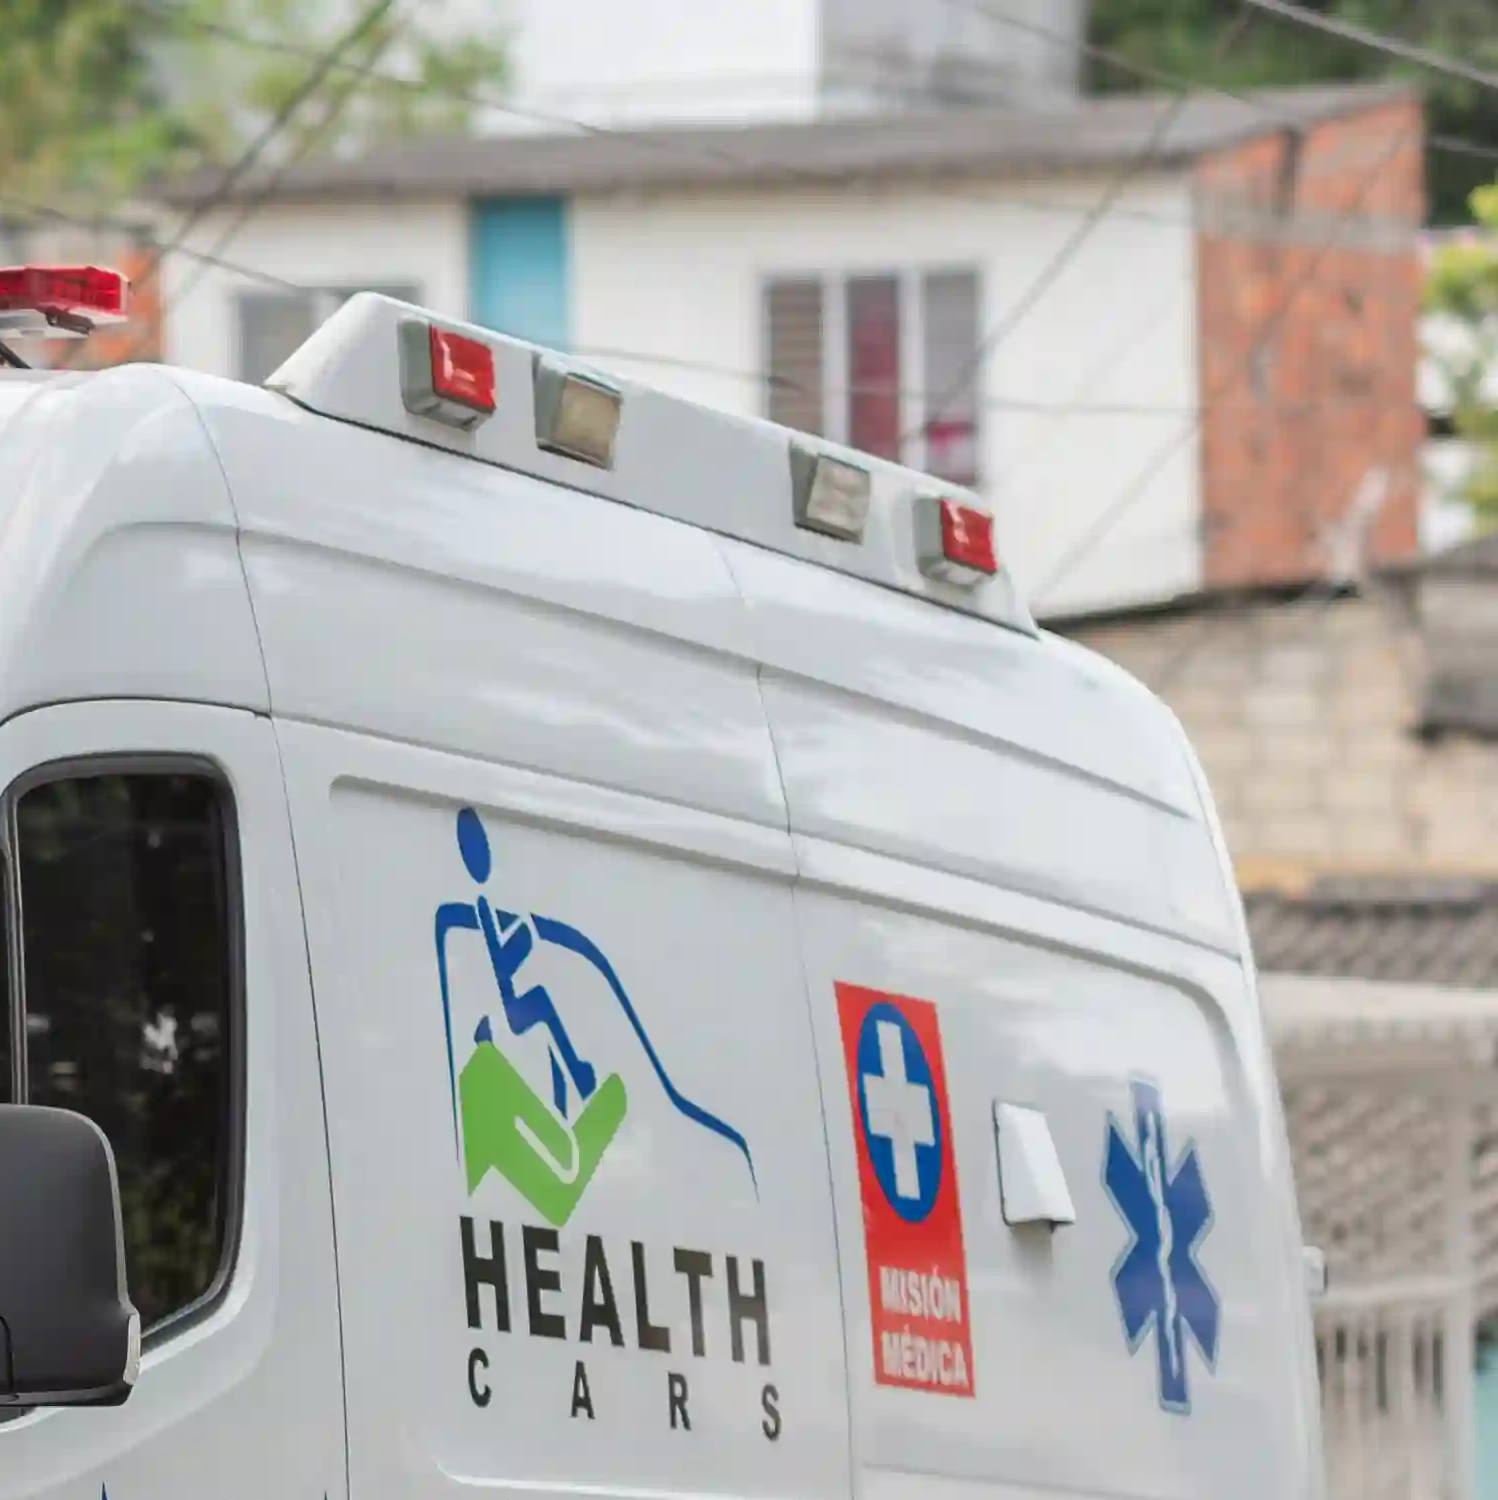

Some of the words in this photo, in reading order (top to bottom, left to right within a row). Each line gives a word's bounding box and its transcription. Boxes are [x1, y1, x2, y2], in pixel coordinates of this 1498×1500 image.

[460, 1216, 770, 1365] HEALTH
[879, 1264, 962, 1325] MISIÓN
[467, 1348, 782, 1441] CARS
[881, 1324, 969, 1388] MÉDICA
